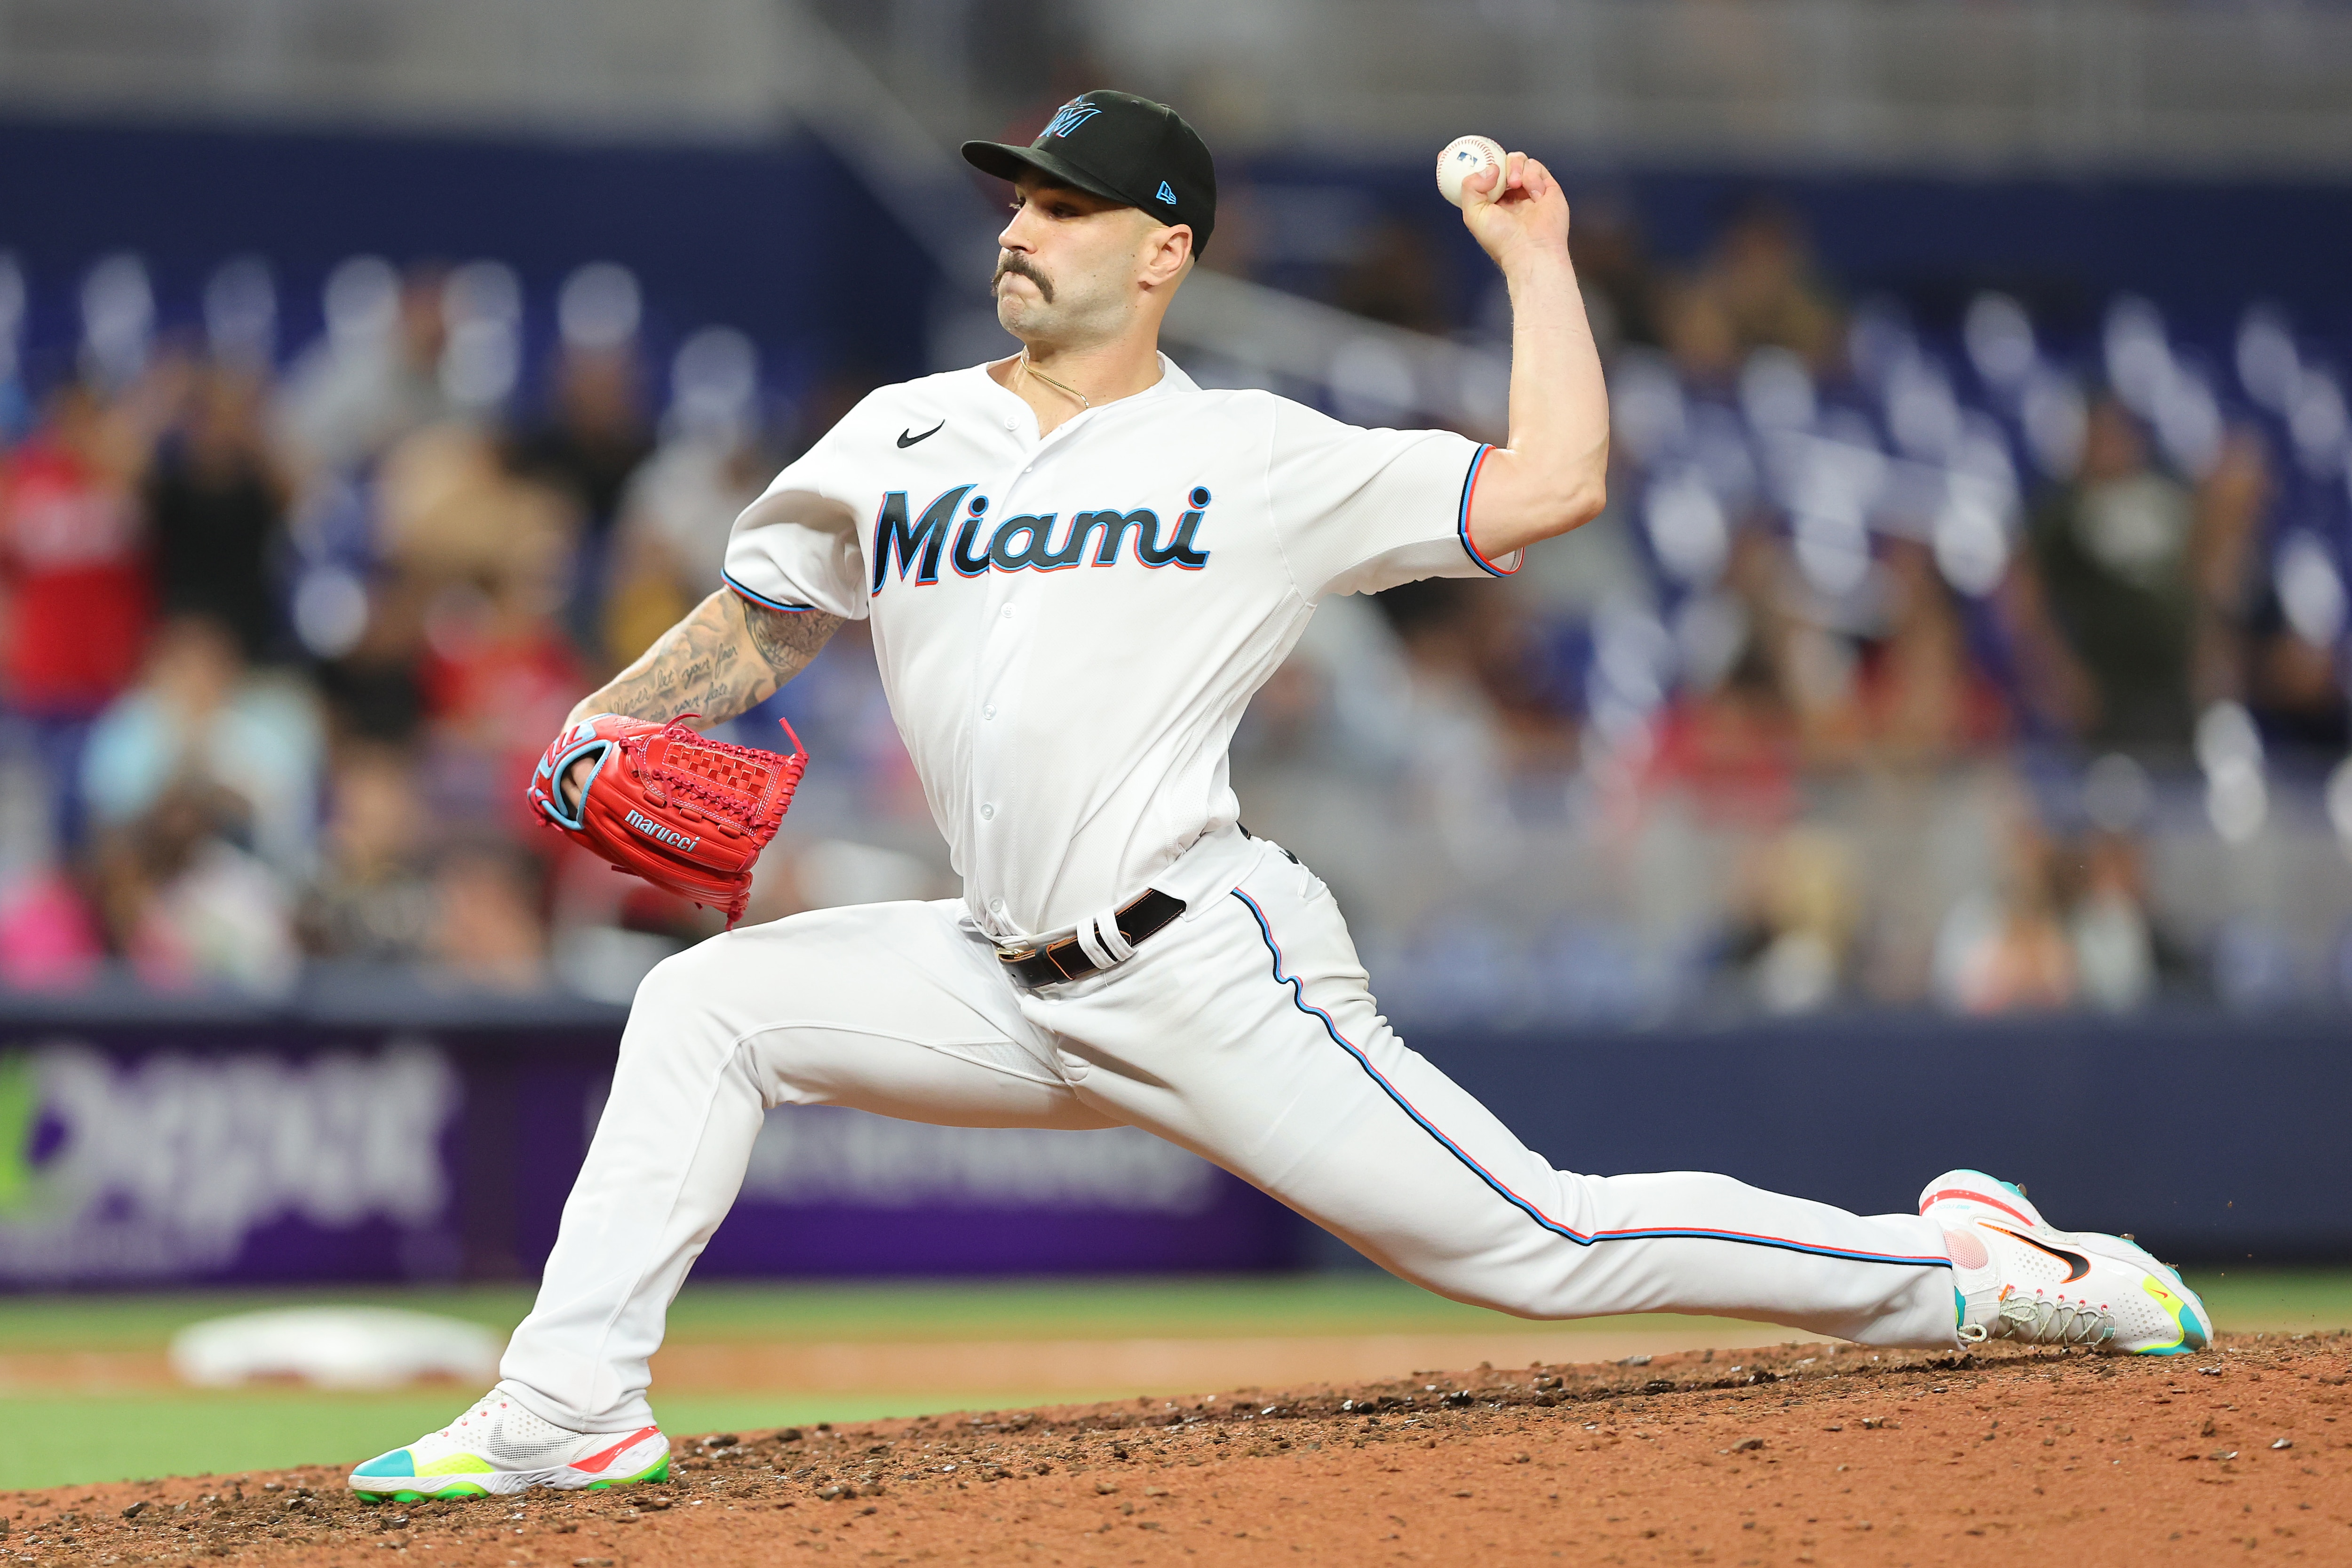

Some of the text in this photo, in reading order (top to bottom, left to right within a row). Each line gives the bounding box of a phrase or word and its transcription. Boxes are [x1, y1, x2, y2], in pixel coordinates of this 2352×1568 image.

[871, 483, 1211, 597] Miami
[657, 669, 674, 691] let
[625, 809, 700, 852] marucci
